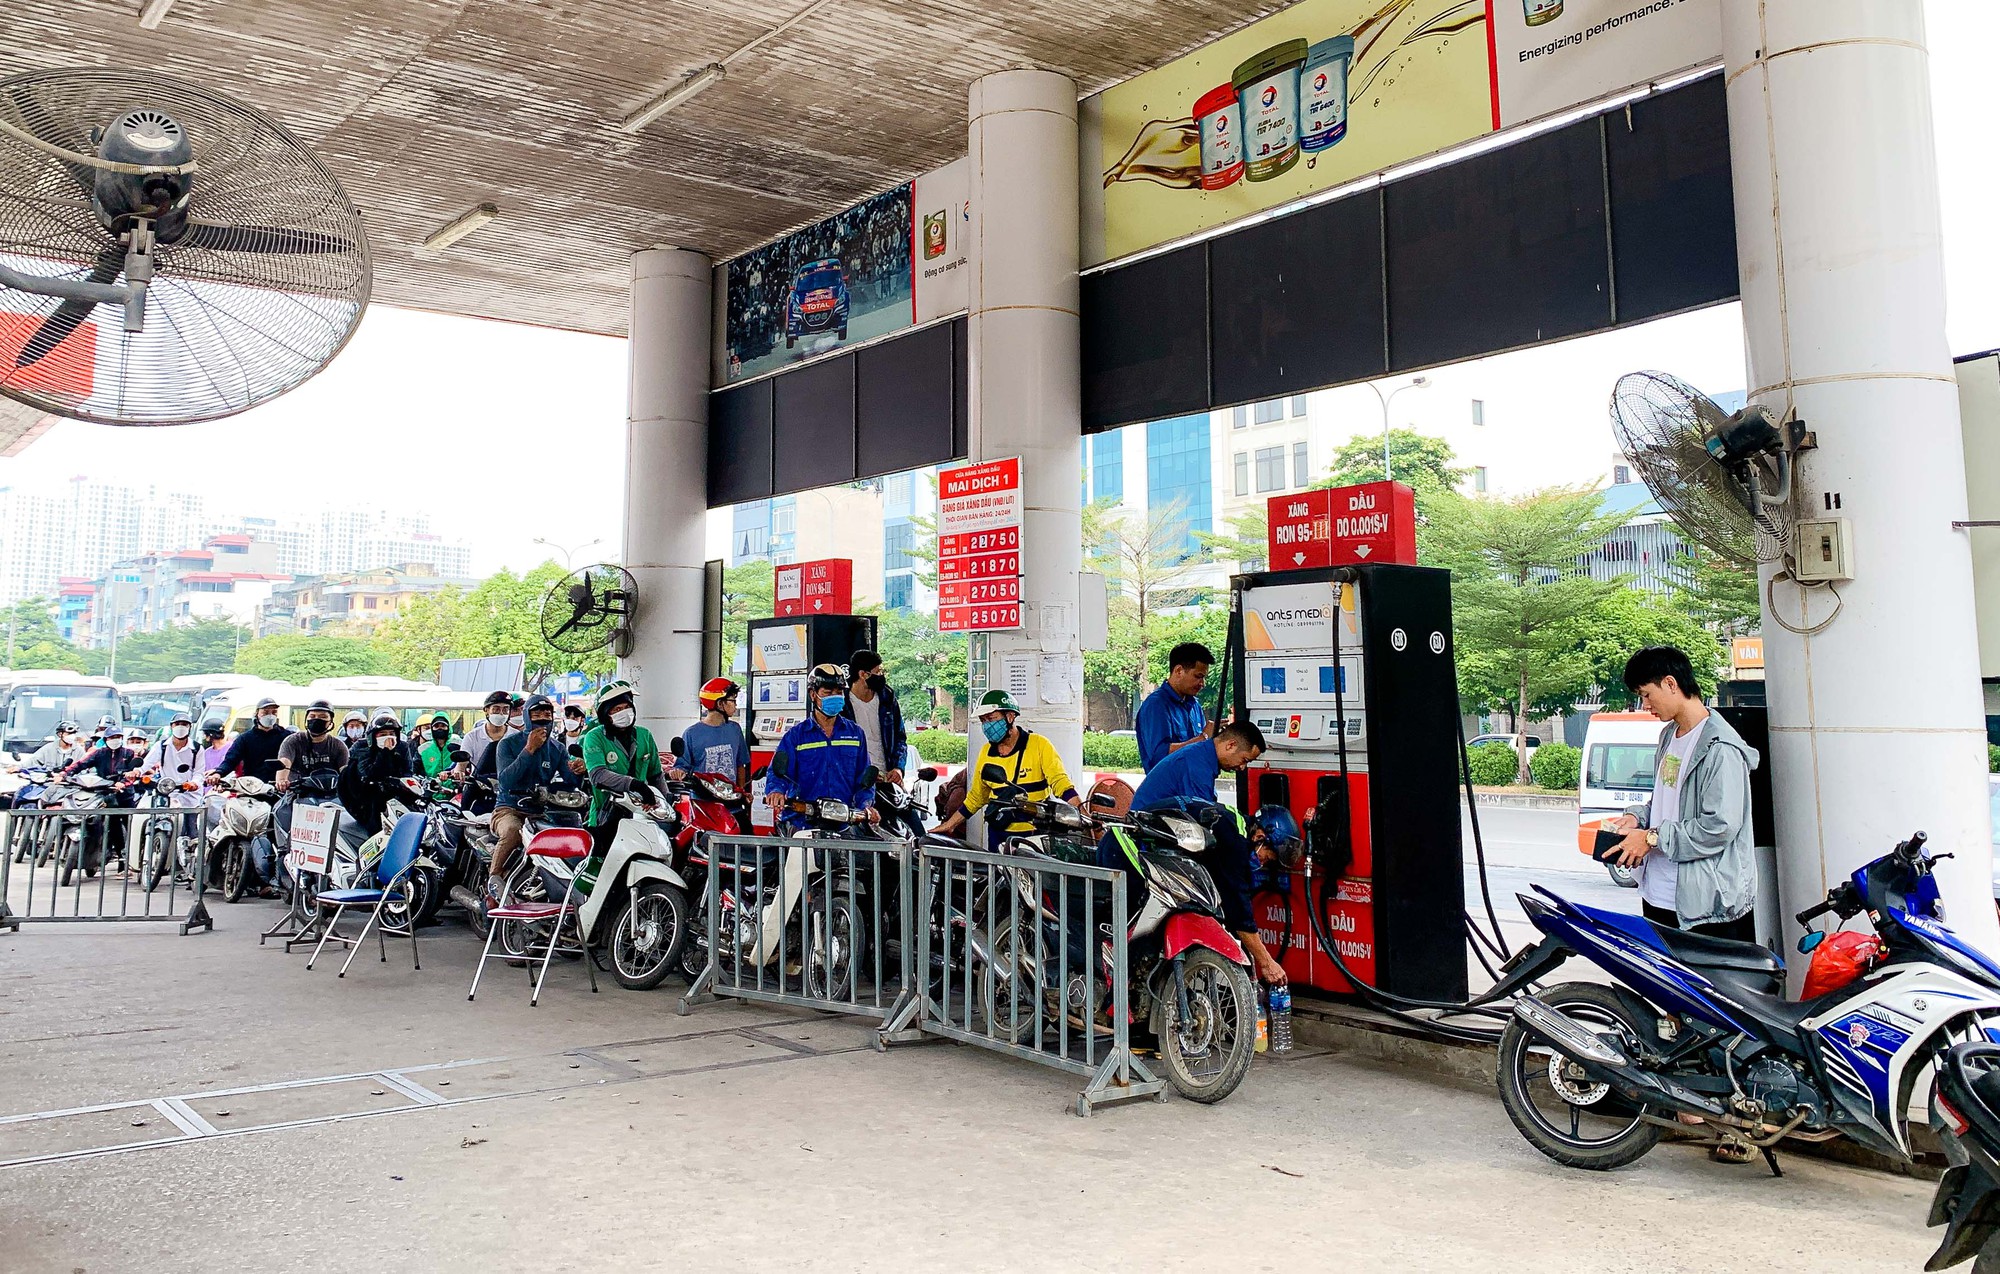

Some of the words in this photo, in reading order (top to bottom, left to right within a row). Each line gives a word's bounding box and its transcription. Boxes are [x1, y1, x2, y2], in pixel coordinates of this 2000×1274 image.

[1519, 31, 1583, 62] Energizing
[1586, 0, 1675, 40] performance.
[1313, 90, 1329, 98] TOTAL
[1261, 106, 1280, 116] TOTAL
[806, 302, 830, 311] TOTAL
[948, 480, 969, 494] MAI
[971, 475, 1000, 492] DỊCH
[1003, 474, 1009, 485] 1
[942, 500, 956, 514] BẢNG
[956, 499, 965, 512] GIÁ
[965, 498, 980, 511] XĂNG
[1349, 490, 1375, 511] DẦU
[1287, 501, 1309, 518] XĂNG
[1276, 525, 1296, 544] RON
[1297, 520, 1330, 543] 95-III
[1336, 517, 1349, 537] DO
[1351, 513, 1389, 536] 0.001S-V
[970, 531, 1016, 550] 22750
[811, 564, 827, 579] XĂNG
[970, 557, 1016, 574] 21870
[806, 583, 818, 596] RON
[971, 582, 1017, 599] 27050
[971, 608, 1017, 625] 25070
[1266, 608, 1293, 621] ants
[1478, 794, 1501, 806] MAY
[313, 831, 321, 843] XE
[1266, 904, 1294, 924] XĂN
[1330, 909, 1356, 933] DẦU
[1904, 913, 1944, 939] YAMAHA
[1341, 940, 1372, 960] 0.001S-V
